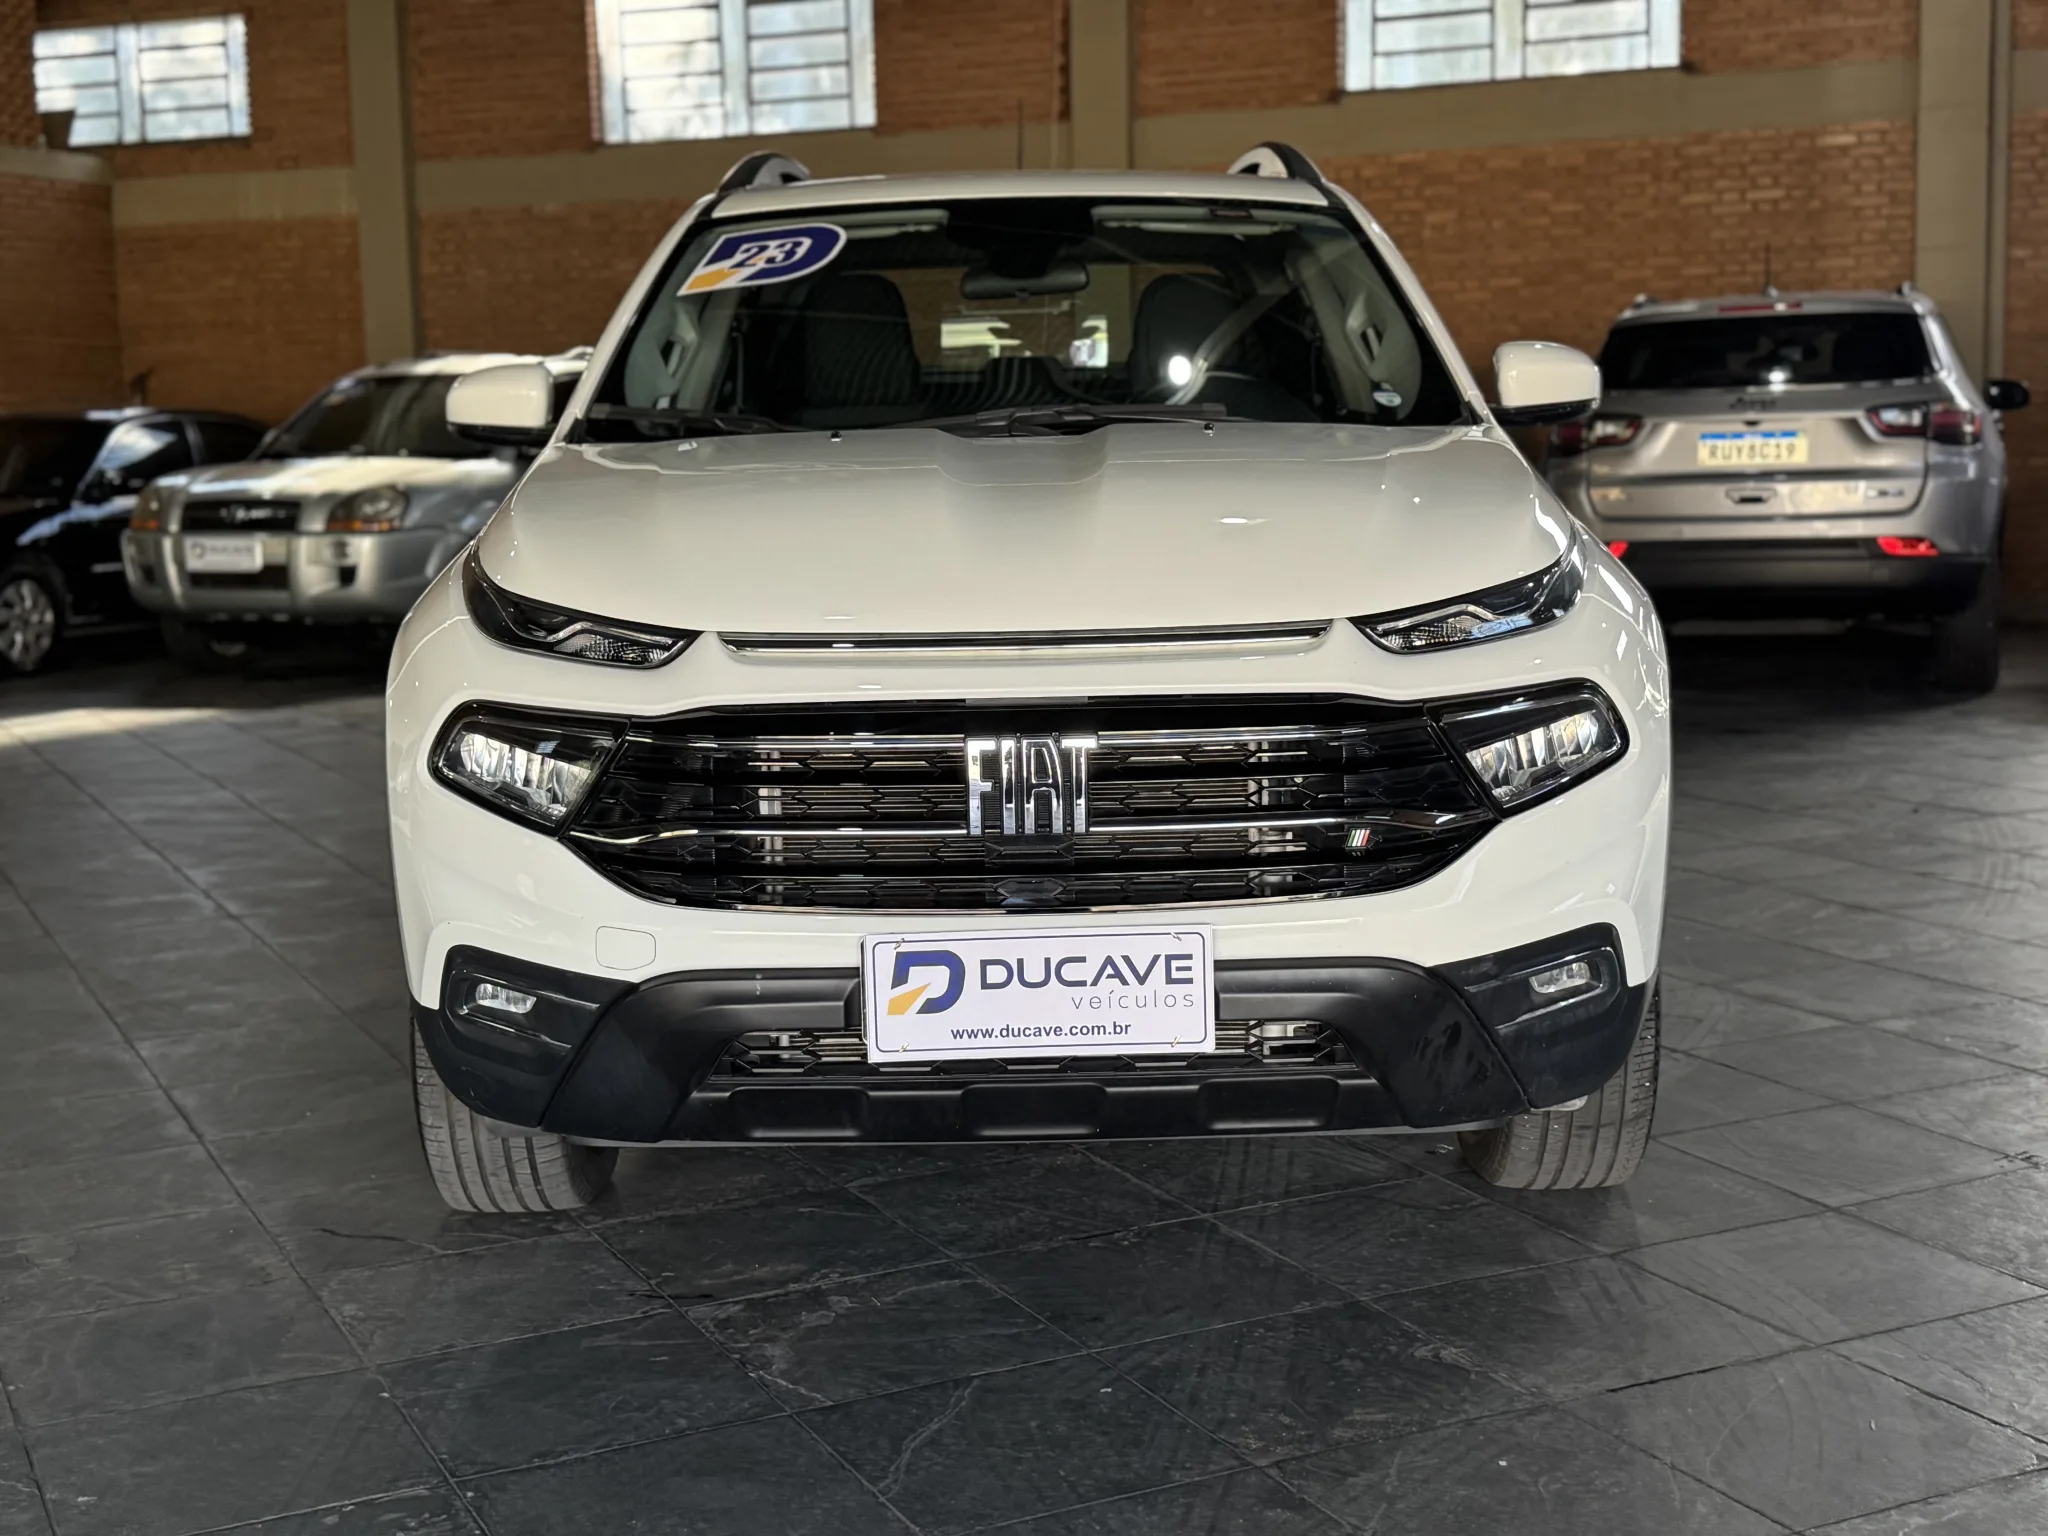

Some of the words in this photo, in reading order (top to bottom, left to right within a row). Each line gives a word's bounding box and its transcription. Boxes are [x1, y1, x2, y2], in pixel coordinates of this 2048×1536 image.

[729, 240, 804, 269] 23
[966, 737, 1098, 835] FIAT
[979, 953, 1195, 991] DUCAVE
[1071, 989, 1195, 1010] veículos
[951, 1021, 1132, 1040] www.ducave.com.br
